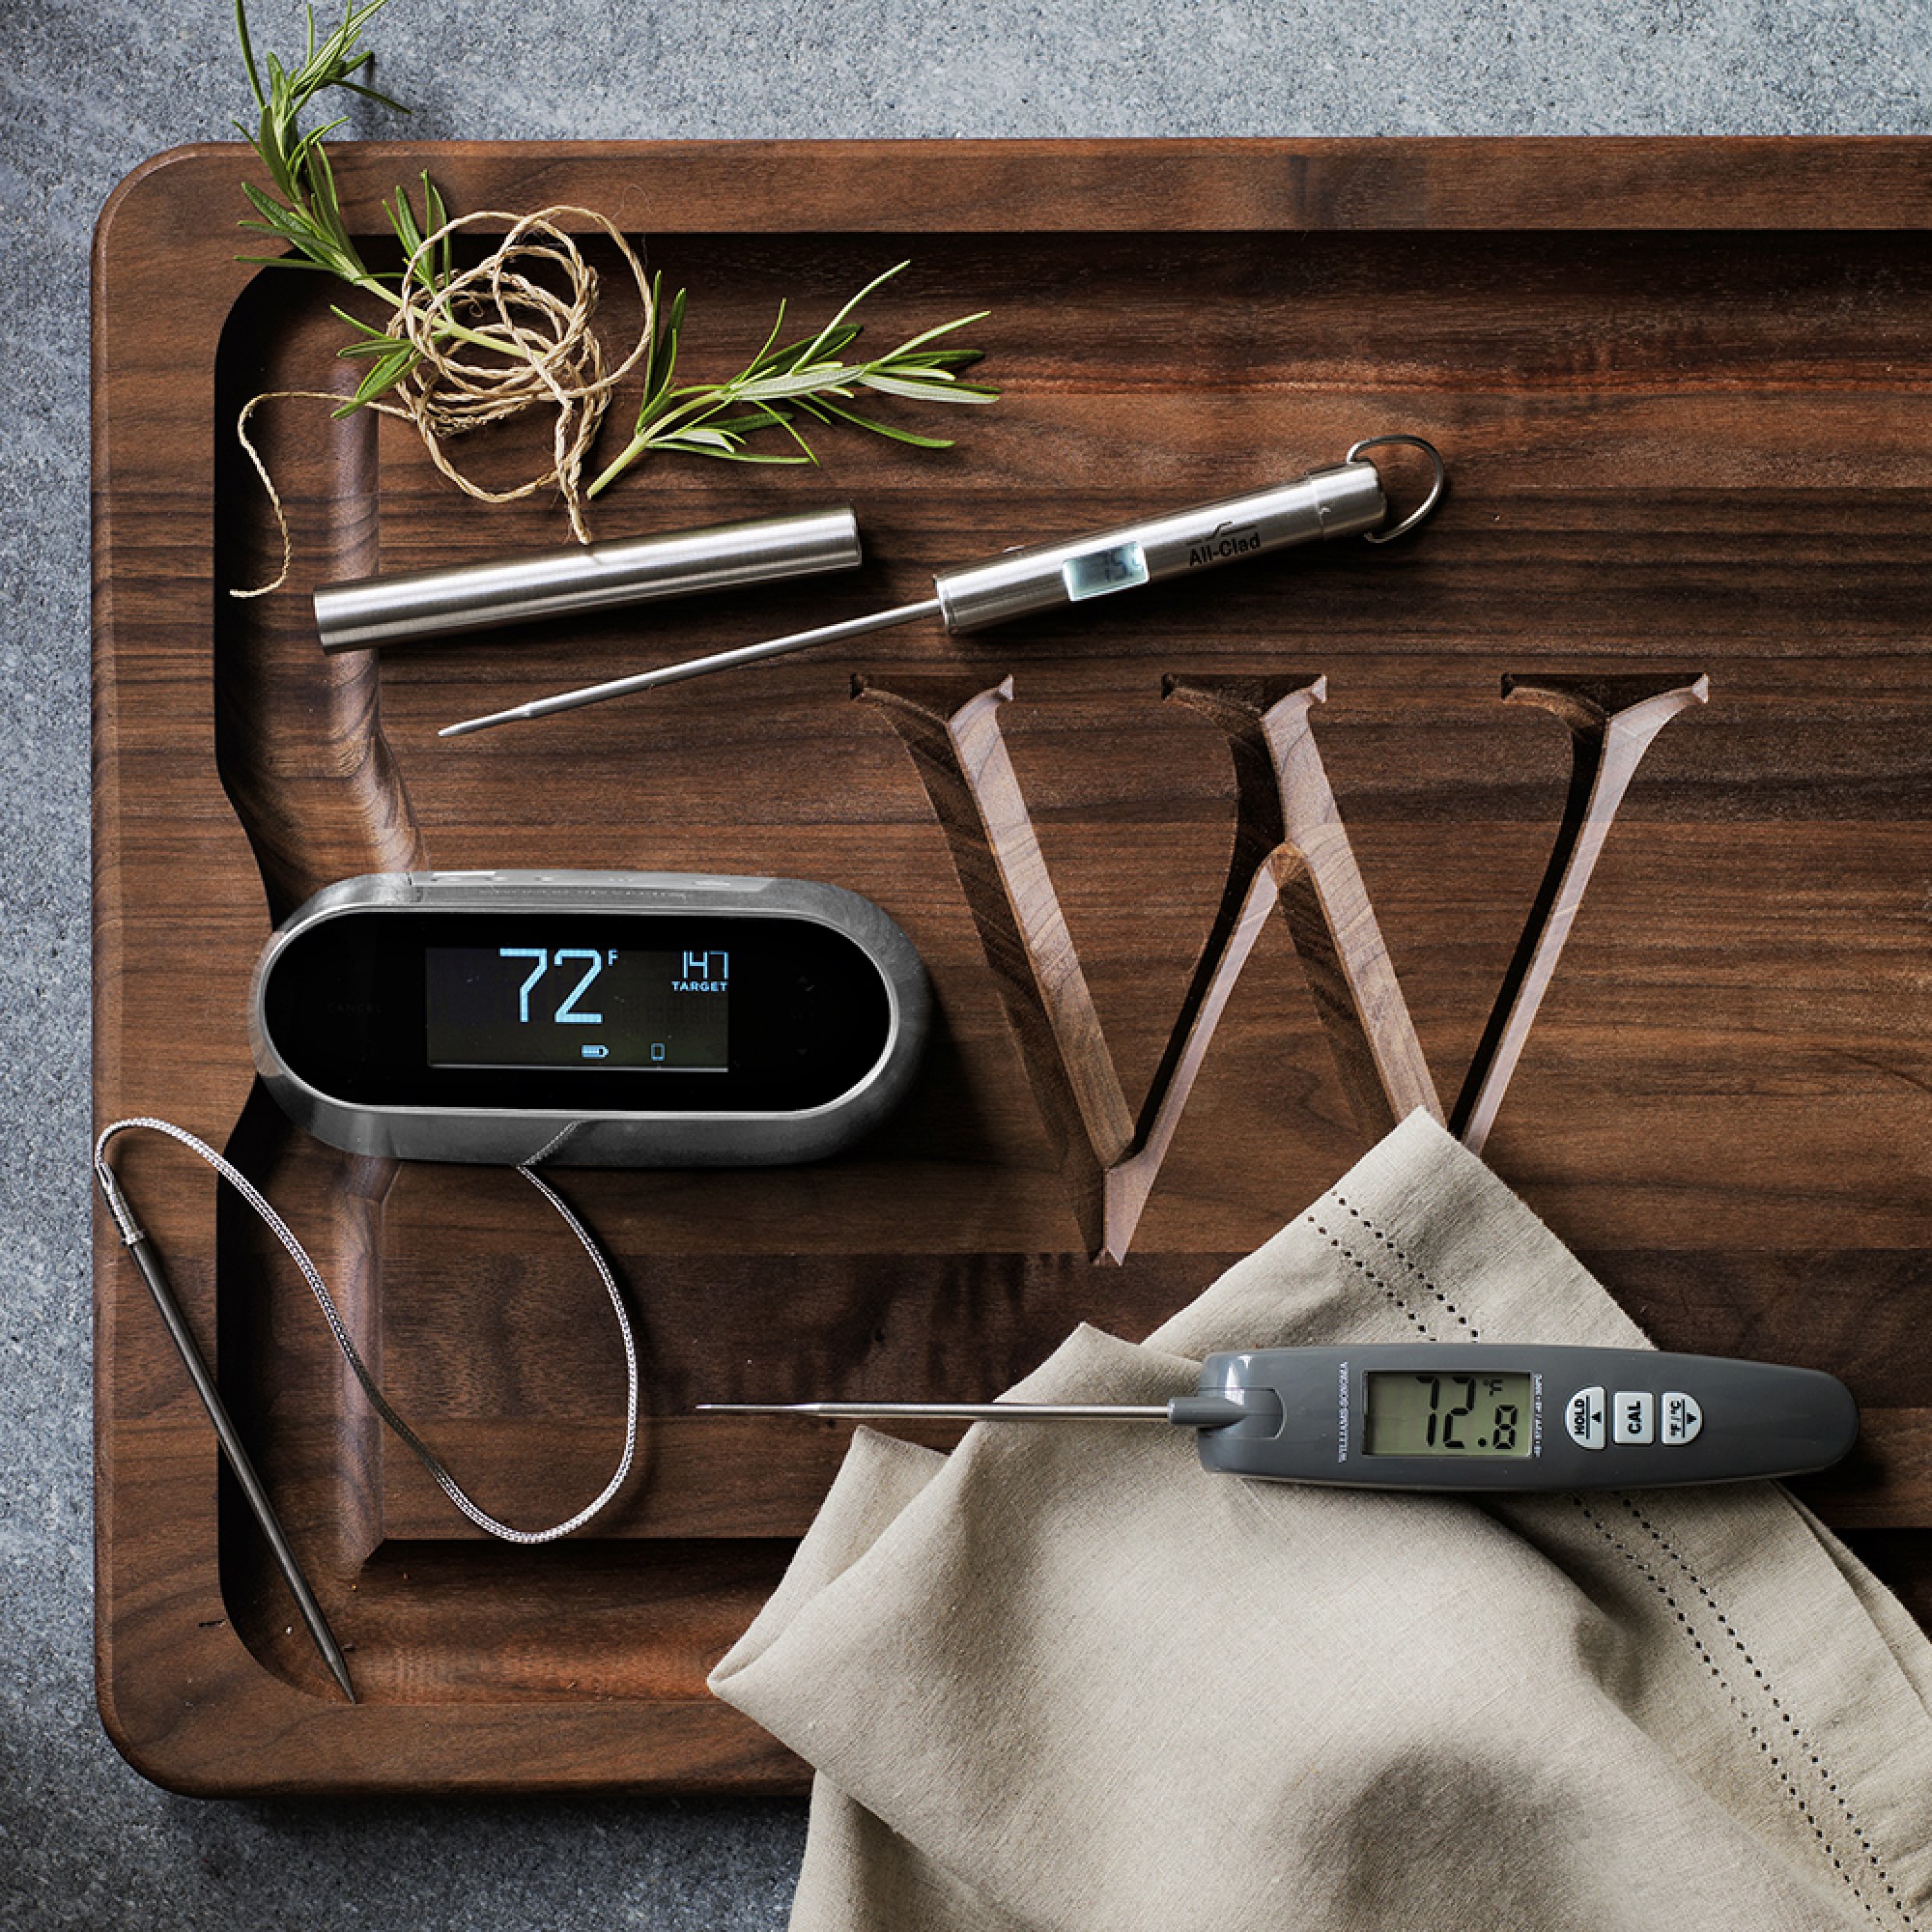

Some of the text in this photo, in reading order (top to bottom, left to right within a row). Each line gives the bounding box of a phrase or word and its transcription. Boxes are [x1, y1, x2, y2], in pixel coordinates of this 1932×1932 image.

[1189, 531, 1261, 567] All-Clad
[683, 951, 729, 980] 147
[850, 673, 1709, 1266] W
[499, 948, 618, 1023] 72 F
[671, 980, 728, 992] TARGET
[1415, 1376, 1519, 1449] 72.8
[1574, 1398, 1585, 1436] HOLD
[1628, 1400, 1642, 1435] CAL
